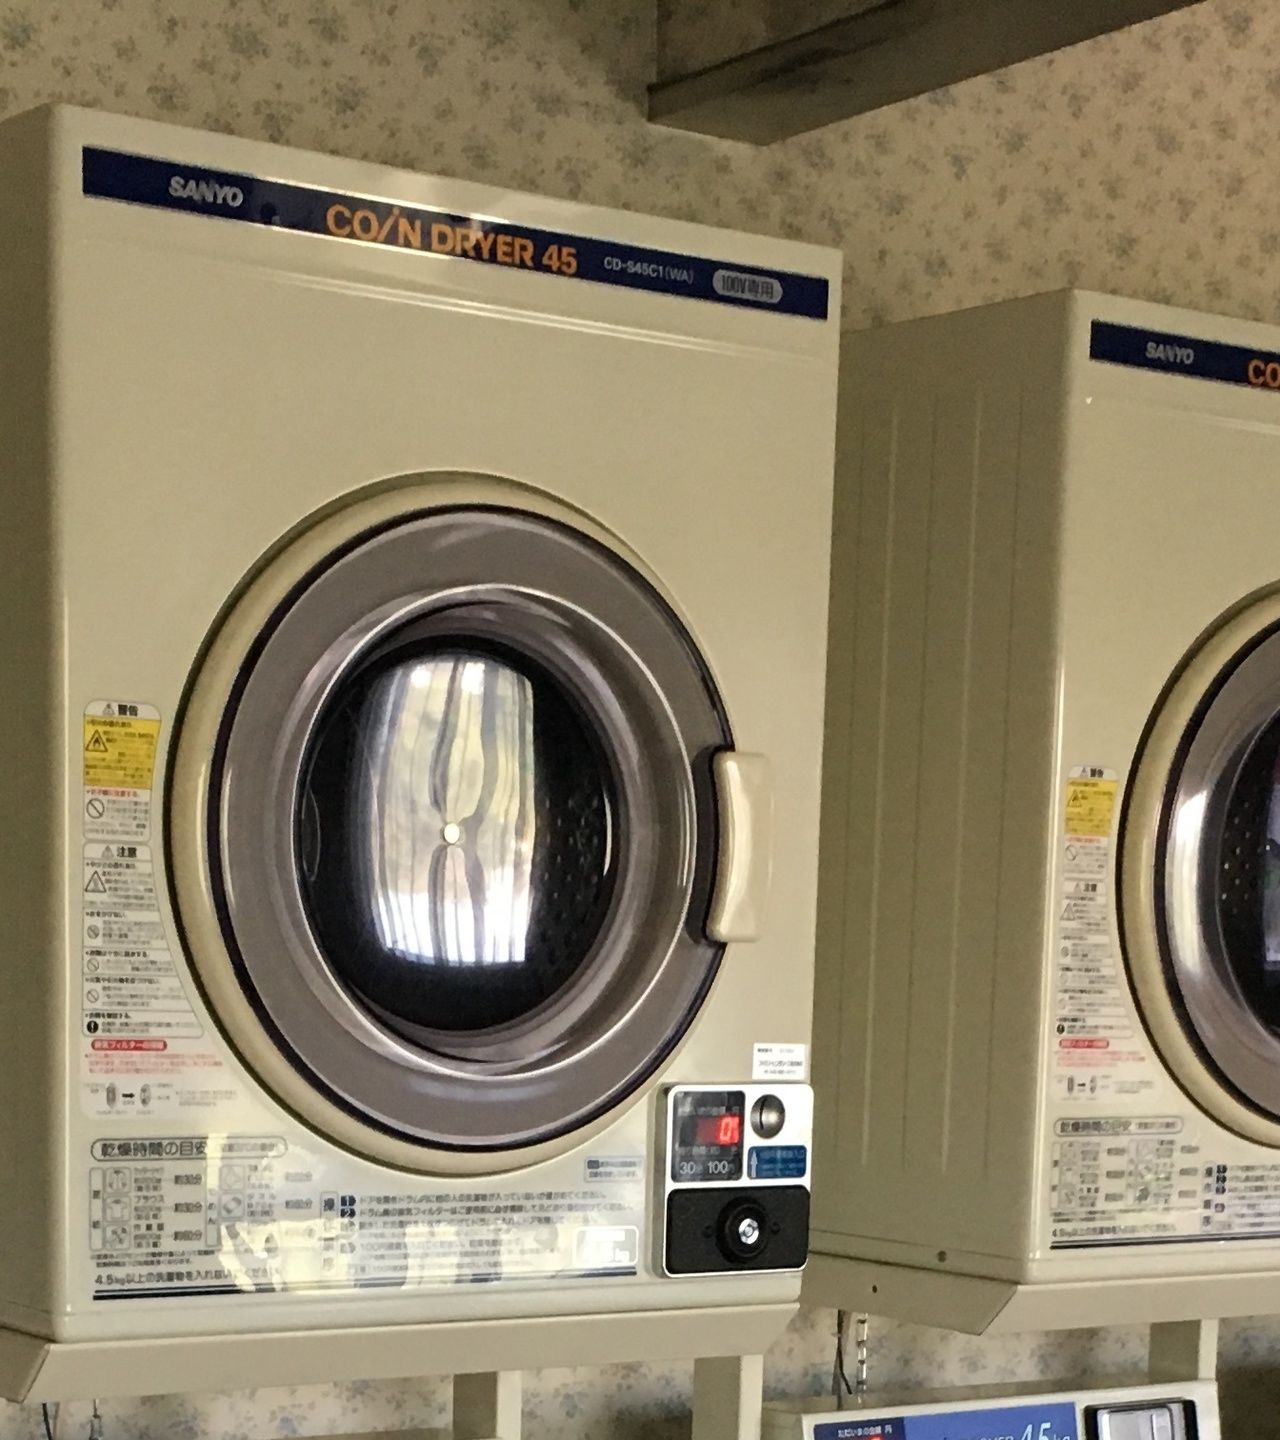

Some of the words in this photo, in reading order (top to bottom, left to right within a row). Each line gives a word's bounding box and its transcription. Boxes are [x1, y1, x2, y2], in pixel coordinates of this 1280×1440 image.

[169, 175, 244, 207] SANYO
[326, 204, 422, 249] COIN
[431, 223, 534, 270] DRYER
[542, 236, 578, 276] 45
[1145, 341, 1195, 365] SANYO
